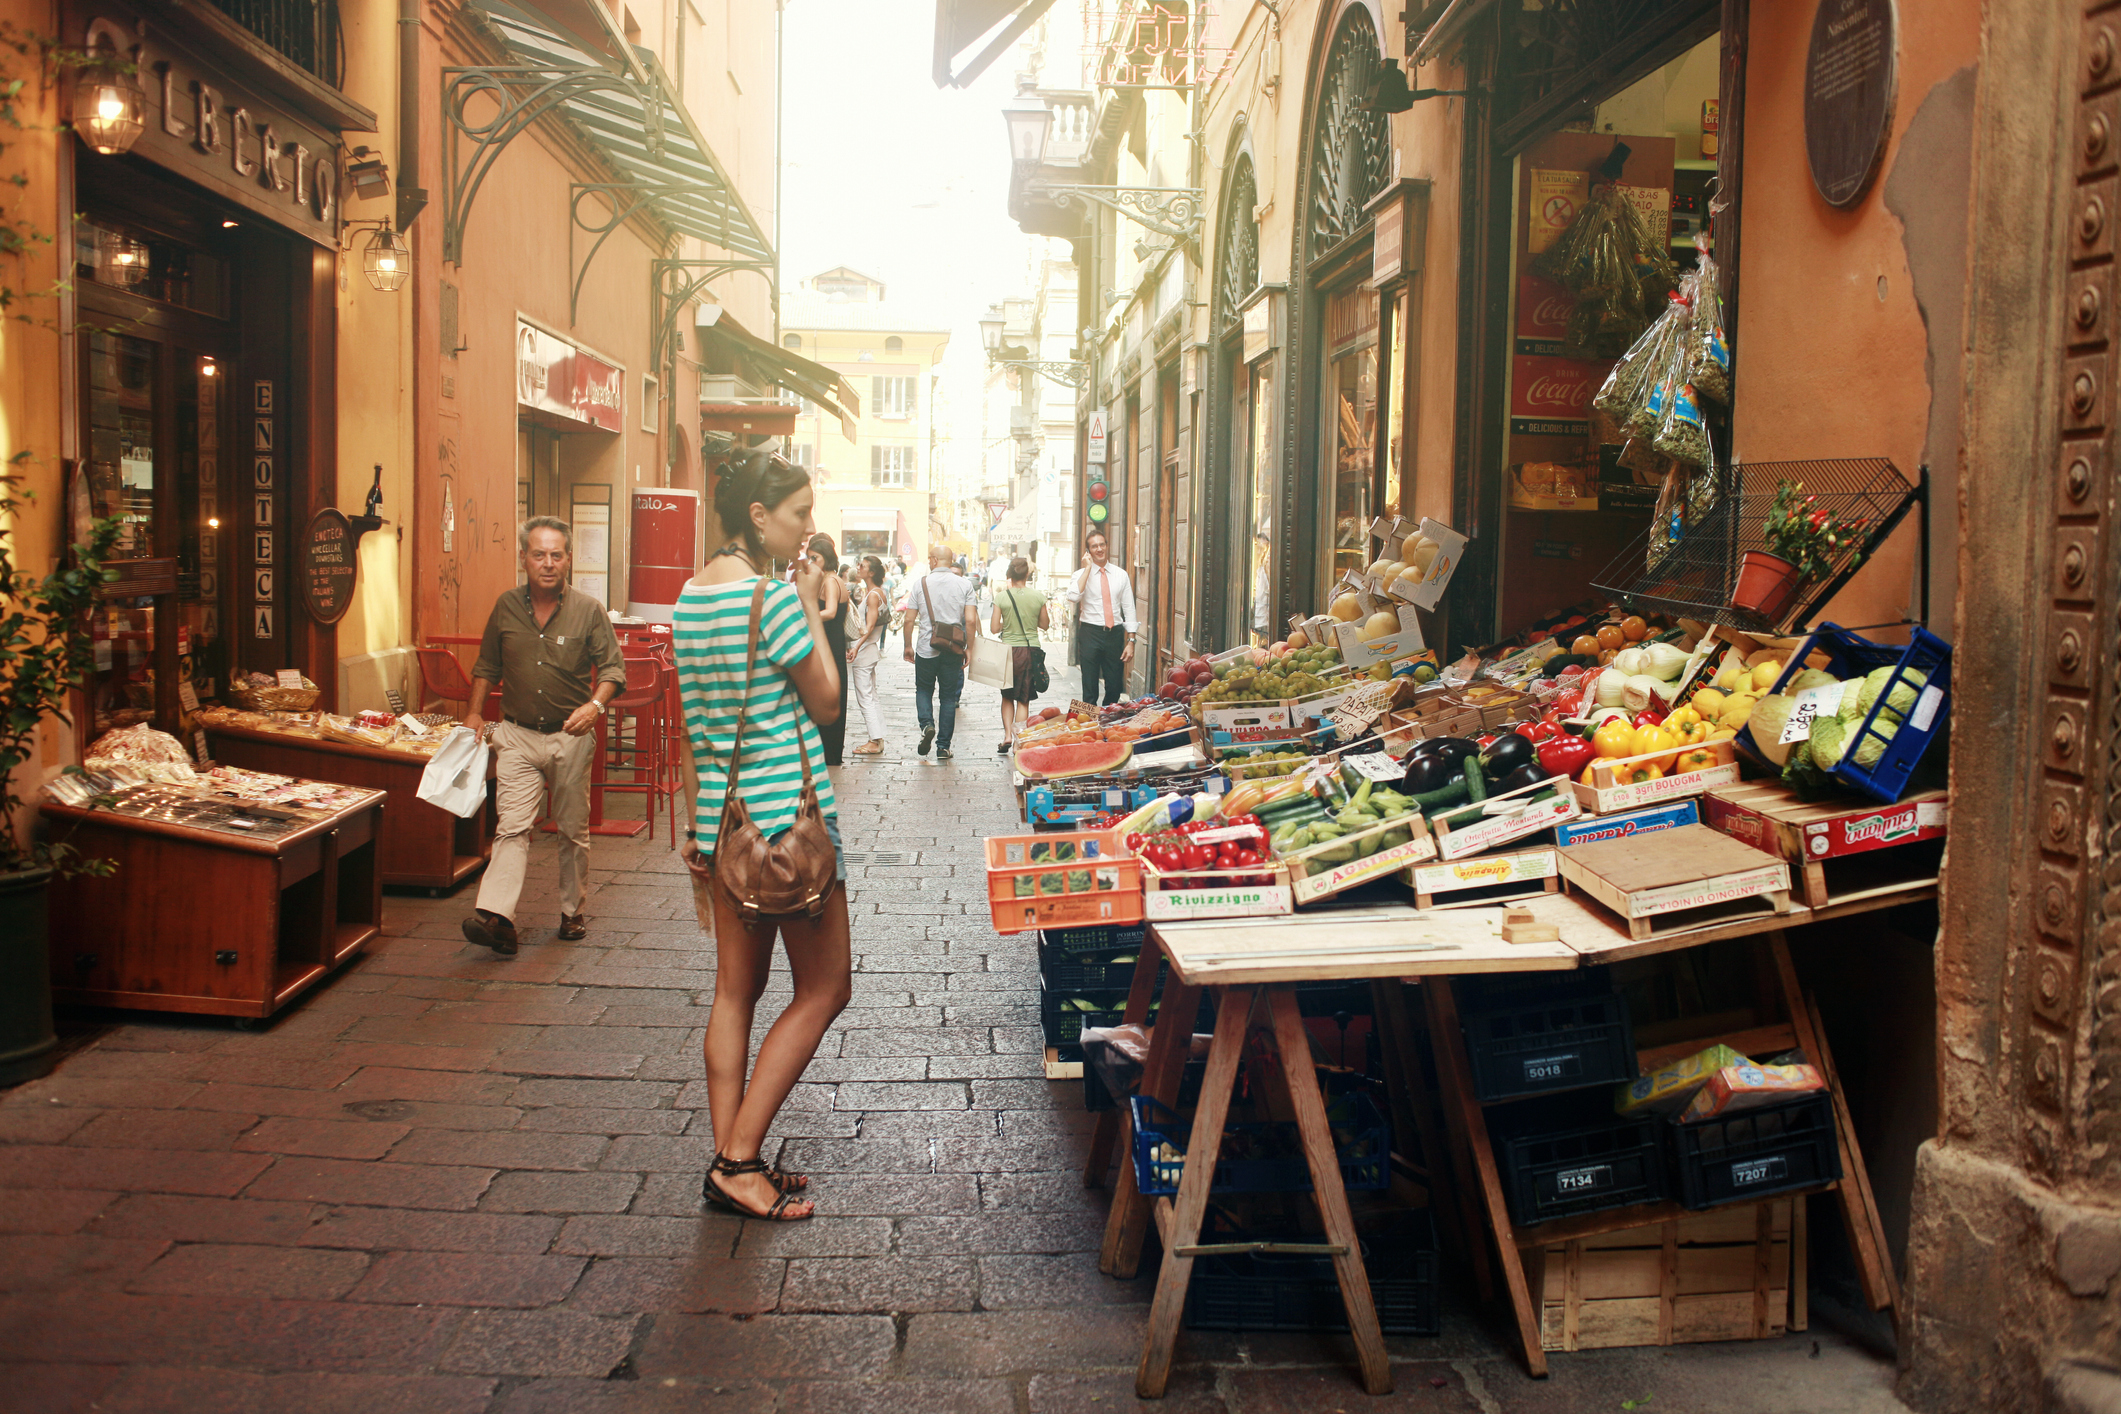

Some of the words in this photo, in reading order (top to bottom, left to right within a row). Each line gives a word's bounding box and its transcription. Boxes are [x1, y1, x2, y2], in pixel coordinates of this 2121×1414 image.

[1555, 369, 1581, 378] DRINK
[1528, 423, 1562, 434] DELICIOUS
[256, 385, 272, 634] ENOTECA
[314, 527, 344, 542] ENOTECA
[1635, 784, 1654, 796] agri
[1655, 773, 1702, 791] BOLOGNA
[1845, 809, 1917, 845] Giuliano
[1464, 826, 1502, 844] Ortofrutta
[1333, 843, 1417, 884] AGRIBOX
[1169, 892, 1260, 906] Rivizzigno
[1693, 894, 1705, 905] DI
[1707, 885, 1755, 901] ANTONIO
[1659, 897, 1690, 910] NIOLA
[1529, 1064, 1561, 1078] 5018
[1561, 1174, 1593, 1188] 7134
[1737, 1167, 1767, 1182] 7207
